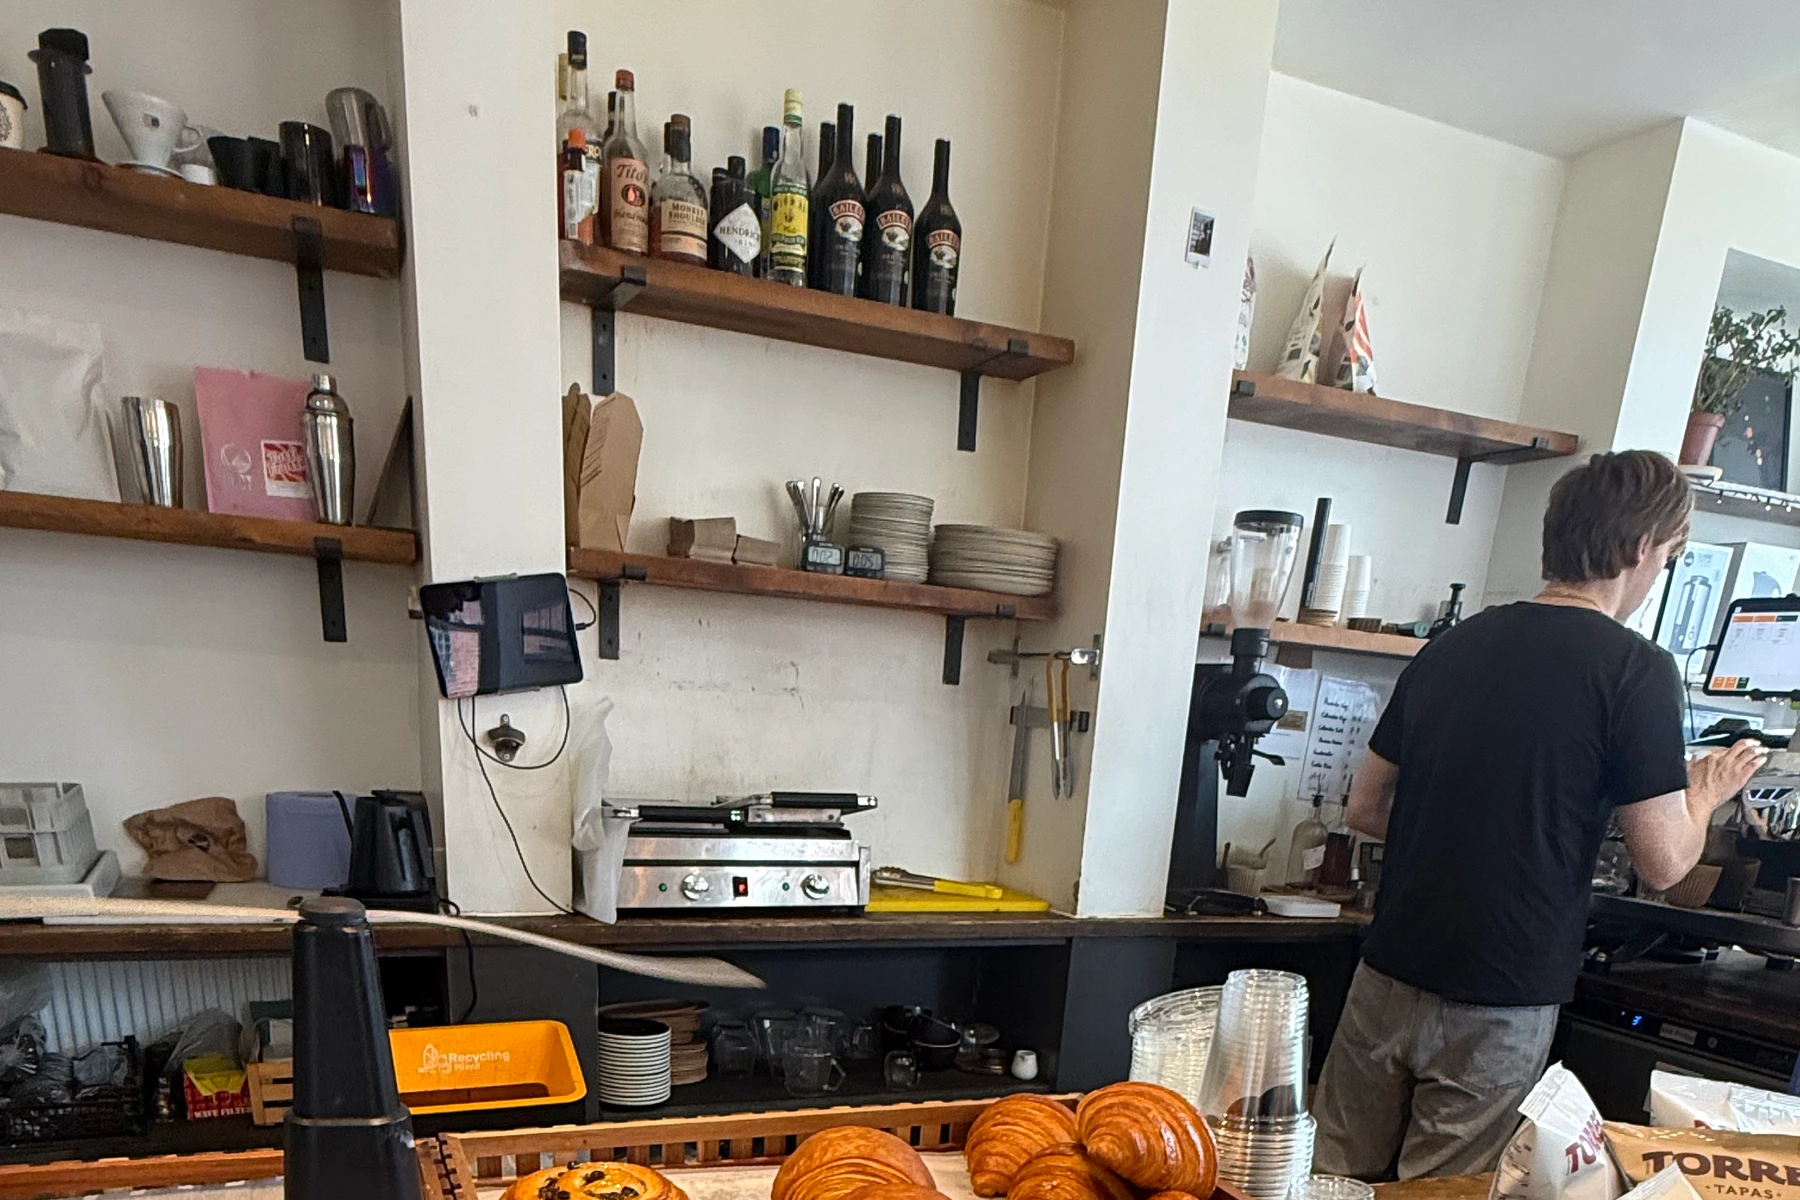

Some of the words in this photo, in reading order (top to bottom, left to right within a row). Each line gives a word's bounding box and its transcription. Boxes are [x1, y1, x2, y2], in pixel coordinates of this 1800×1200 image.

[448, 1050, 511, 1063] Recycling
[1641, 1151, 1800, 1187] TORRE
[1714, 1184, 1774, 1200] TAPAS
